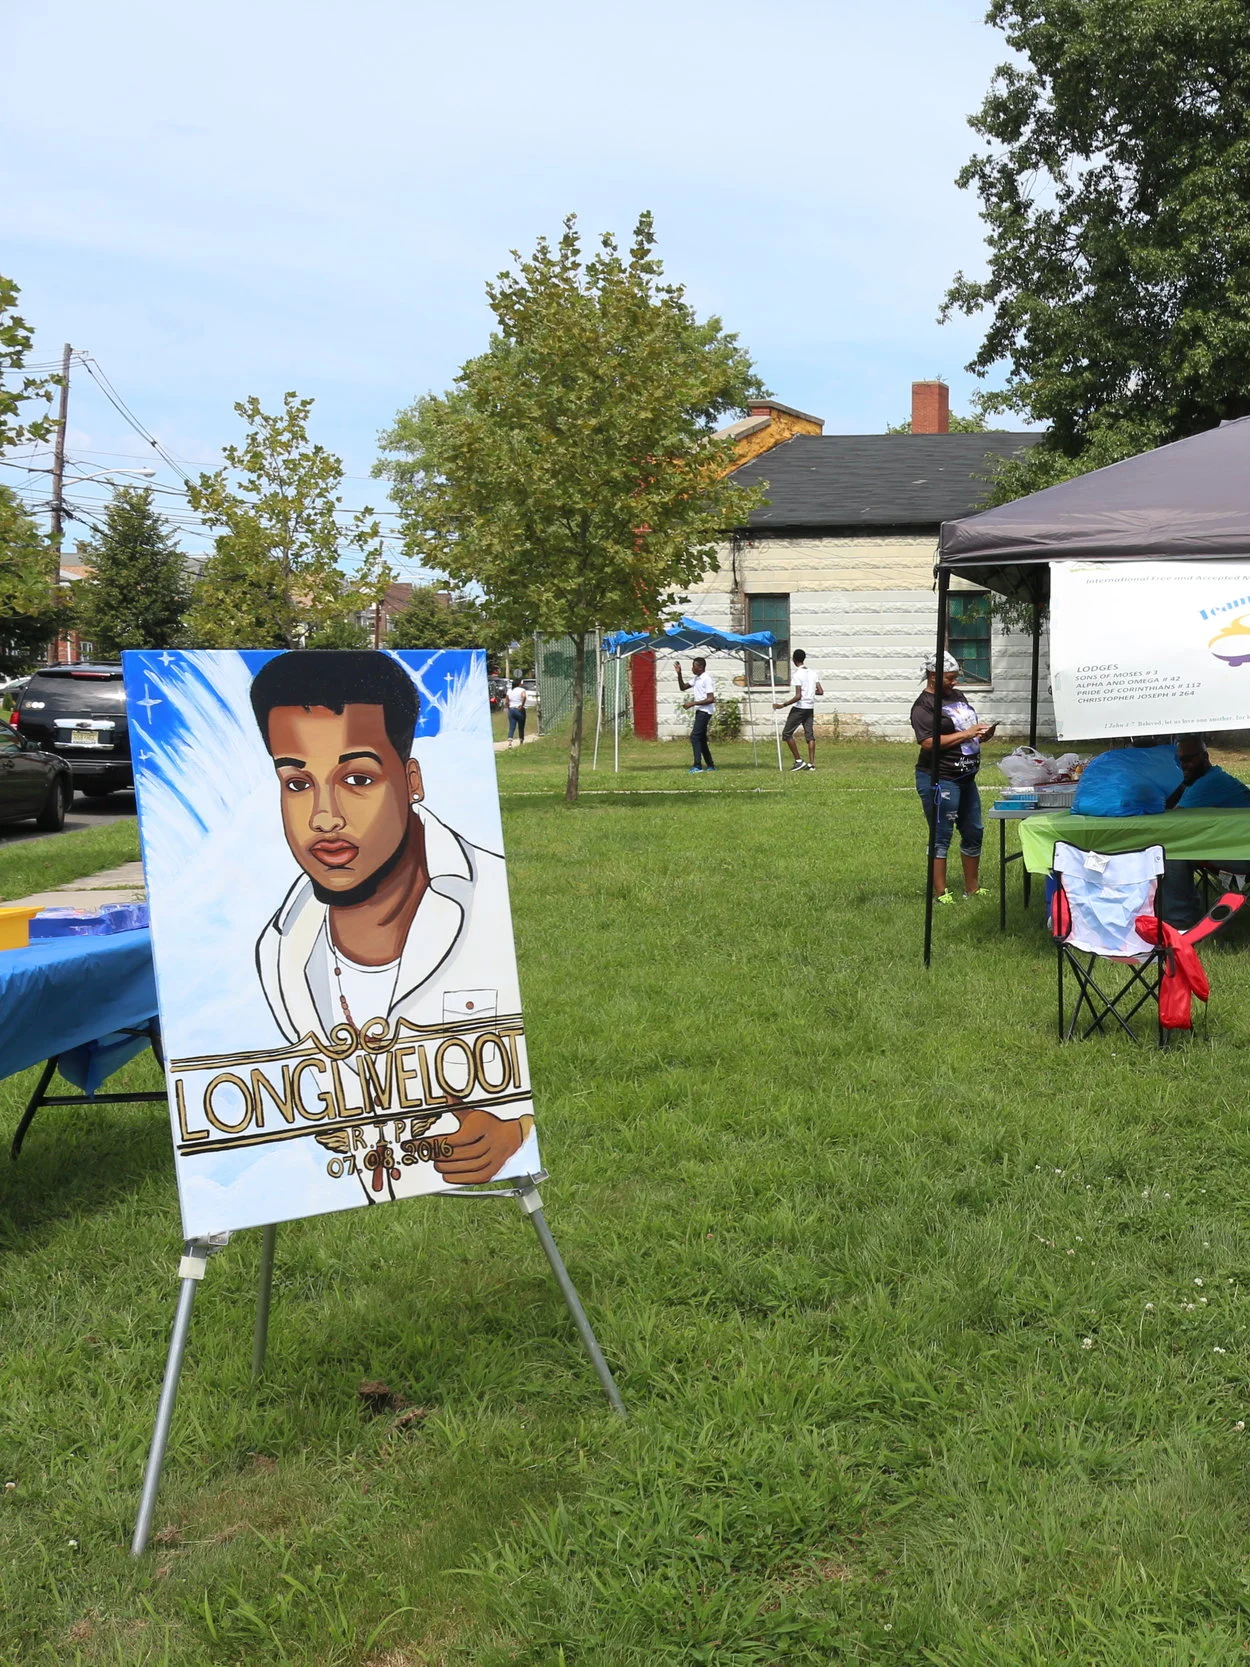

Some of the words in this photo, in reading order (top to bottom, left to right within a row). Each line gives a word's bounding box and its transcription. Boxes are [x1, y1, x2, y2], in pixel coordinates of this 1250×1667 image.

[1077, 663, 1119, 673] LODGES
[1075, 674, 1098, 682] SONS
[1113, 671, 1143, 679] MOSES
[1075, 681, 1104, 689] ALPHA
[1106, 679, 1126, 687] AND
[1127, 677, 1160, 685] OMEGA
[1077, 689, 1101, 697] PRIDE
[1117, 684, 1176, 694] CORINTHIANS
[1077, 694, 1136, 704] CHRISTOPHER
[1137, 692, 1169, 700] JOSEPH
[327, 1137, 454, 1178] 07.08.2016
